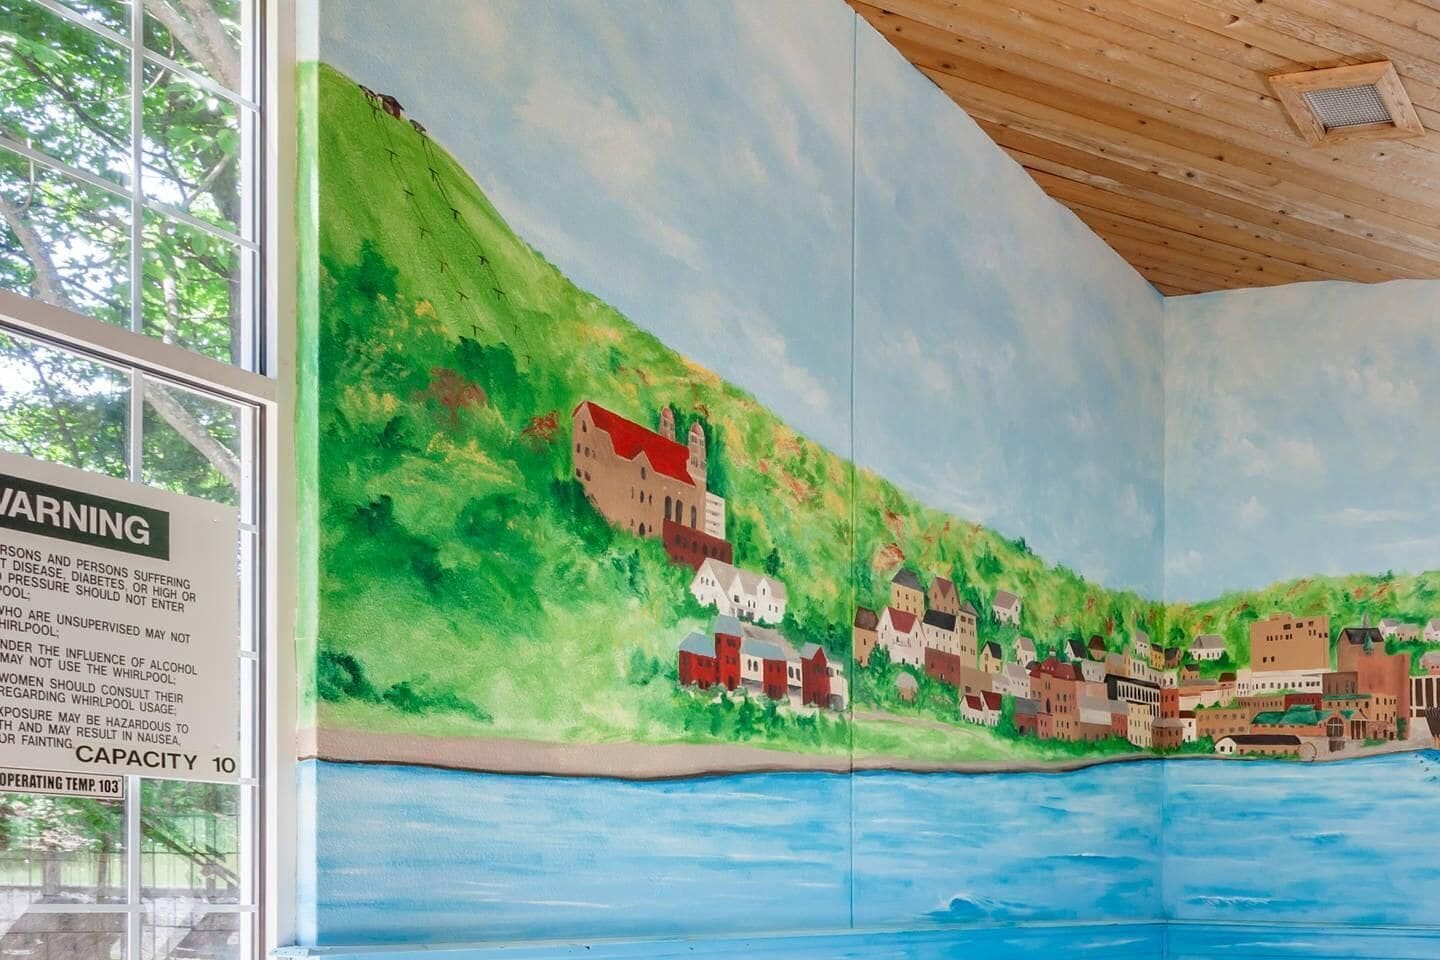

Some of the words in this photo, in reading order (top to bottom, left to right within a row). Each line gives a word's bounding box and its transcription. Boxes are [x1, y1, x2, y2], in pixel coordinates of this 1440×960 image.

[13, 560, 66, 580] DISEASE,
[71, 571, 128, 592] DIABETES,
[133, 583, 148, 594] OR
[153, 586, 177, 599] HIGH
[182, 591, 196, 602] OR
[48, 554, 71, 567] AND
[77, 559, 128, 578] PERSONS
[134, 570, 190, 589] SUFFERING
[8, 573, 70, 593] PRESSURE
[76, 584, 120, 601] SHOULD
[126, 594, 147, 606] NOT
[152, 598, 185, 613] ENTER
[28, 610, 51, 622] ARE
[57, 614, 140, 636] UNSUPERVISED
[145, 628, 166, 640] MAY
[171, 632, 191, 643] NOT
[0, 652, 23, 664] MAY
[30, 656, 53, 668] NOT
[58, 660, 81, 672] USE
[87, 664, 107, 676] THE
[113, 667, 176, 685] WHIRLPOOL;
[37, 644, 60, 656] THE
[66, 648, 126, 665] INFLUENCE
[131, 657, 145, 667] OF
[150, 660, 198, 675] ALCOHOL
[0, 673, 44, 687] WOMEN
[50, 679, 95, 693] SHOULD
[101, 684, 150, 699] CONSULT
[155, 691, 183, 703] THEIR
[71, 694, 135, 710] WHIRLPOOL
[140, 701, 177, 716] USAGE;
[18, 721, 43, 733] AND
[48, 724, 71, 735] MAY
[76, 726, 117, 740] RESULT
[122, 730, 132, 741] IN
[137, 732, 181, 746] NAUSEA,
[58, 712, 81, 723] MAY
[86, 715, 101, 726] BE
[106, 716, 171, 732] HAZARDOUS
[176, 723, 189, 734] TO
[75, 745, 197, 770] CAPACITY
[212, 757, 236, 773] 10
[0, 772, 63, 790] OPERATING
[65, 777, 96, 792] TEMP.
